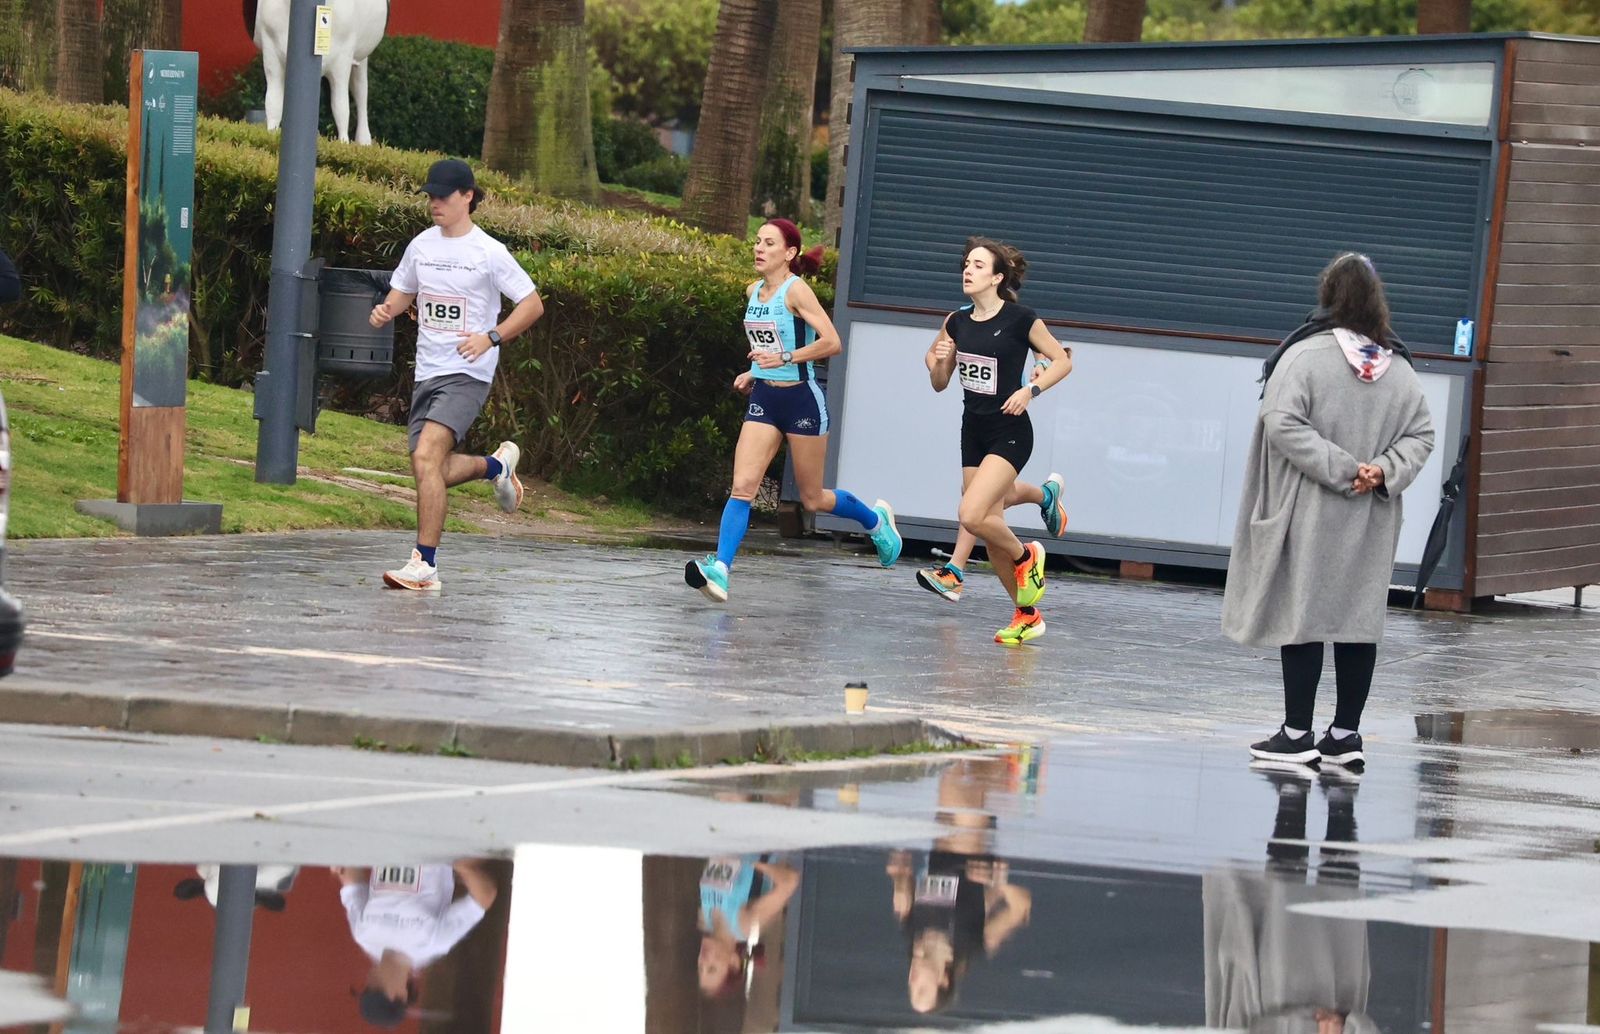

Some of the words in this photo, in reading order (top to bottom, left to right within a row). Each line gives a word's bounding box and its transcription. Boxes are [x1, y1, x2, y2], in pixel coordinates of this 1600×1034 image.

[425, 302, 461, 320] 189
[748, 329, 775, 344] 163
[958, 361, 992, 381] 226
